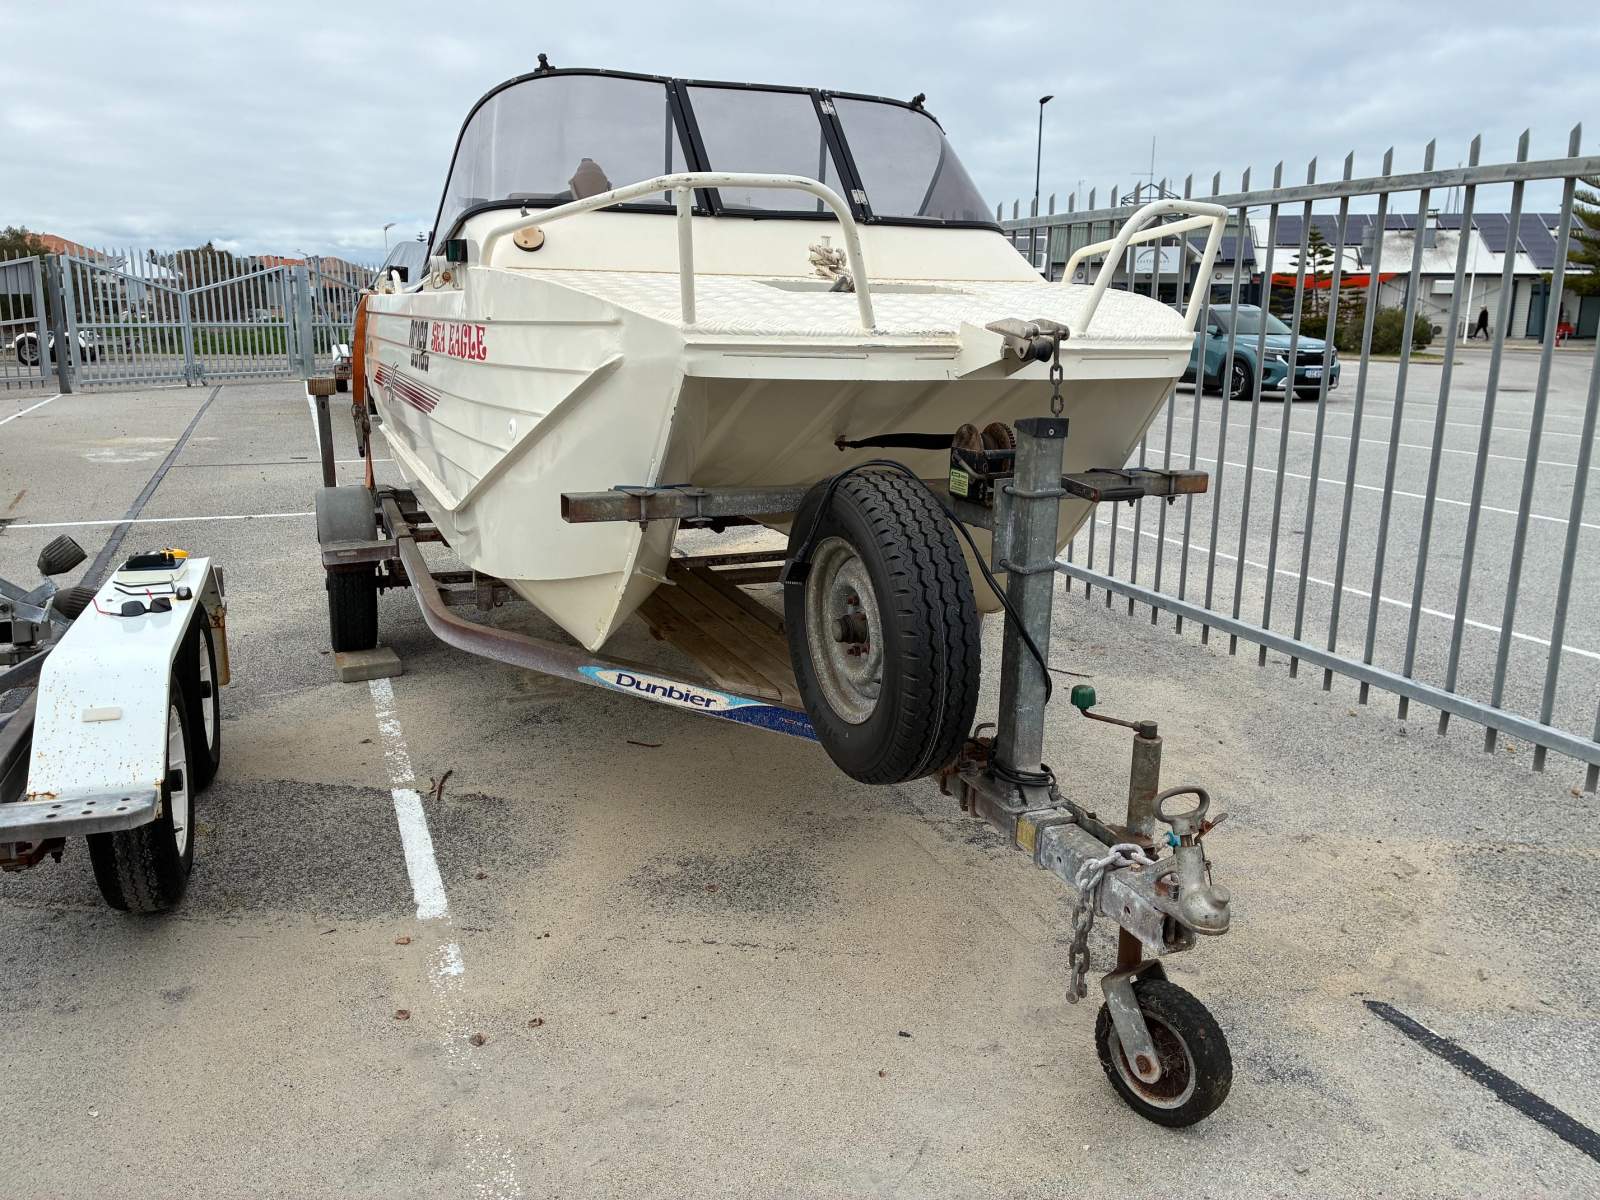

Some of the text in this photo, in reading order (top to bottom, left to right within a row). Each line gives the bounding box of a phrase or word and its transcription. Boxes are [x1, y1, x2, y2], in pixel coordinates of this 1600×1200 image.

[431, 321, 445, 352] SEA
[448, 323, 487, 360] EAGLE
[616, 673, 717, 708] Dunbier
